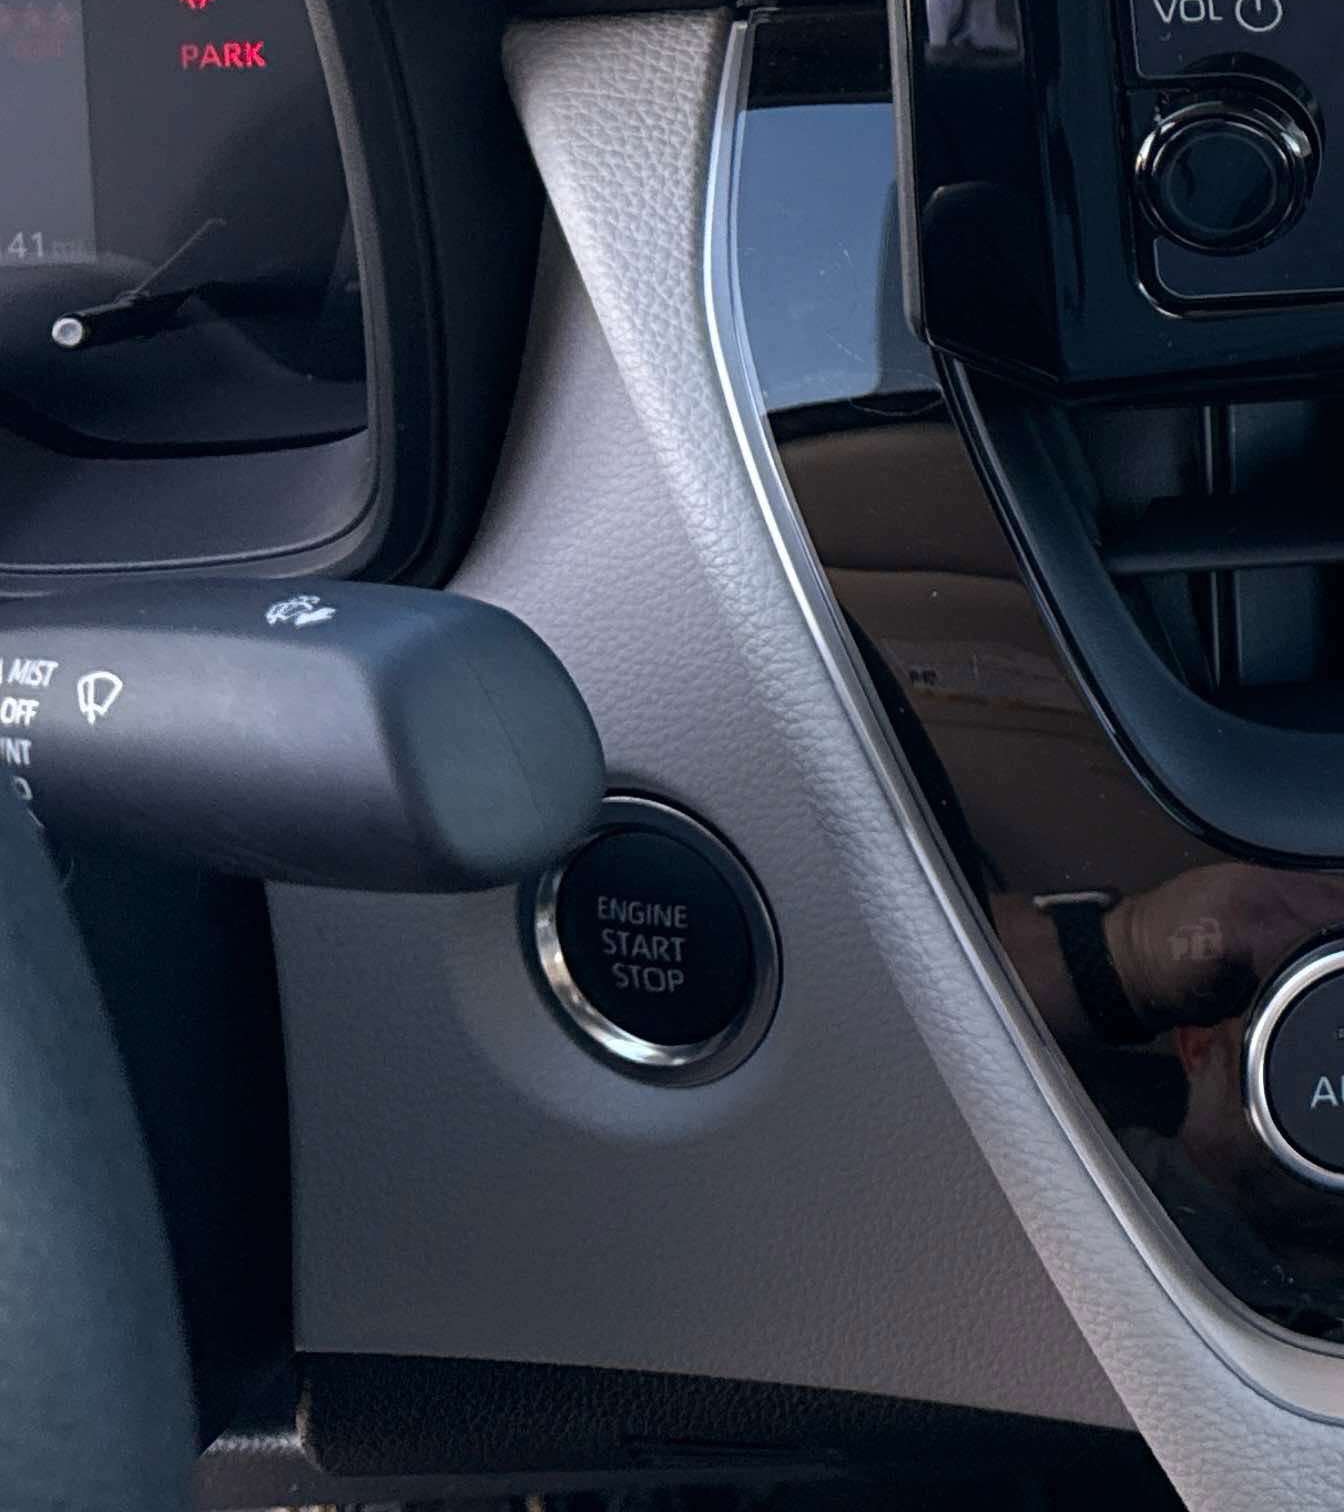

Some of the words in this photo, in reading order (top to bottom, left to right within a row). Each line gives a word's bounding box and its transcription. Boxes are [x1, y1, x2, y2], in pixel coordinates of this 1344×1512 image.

[181, 40, 266, 69] PARK
[7, 658, 58, 687] MIST
[0, 697, 39, 727] OFF
[598, 895, 687, 928] ENGINE
[602, 928, 686, 962] START
[613, 963, 684, 992] STOP
